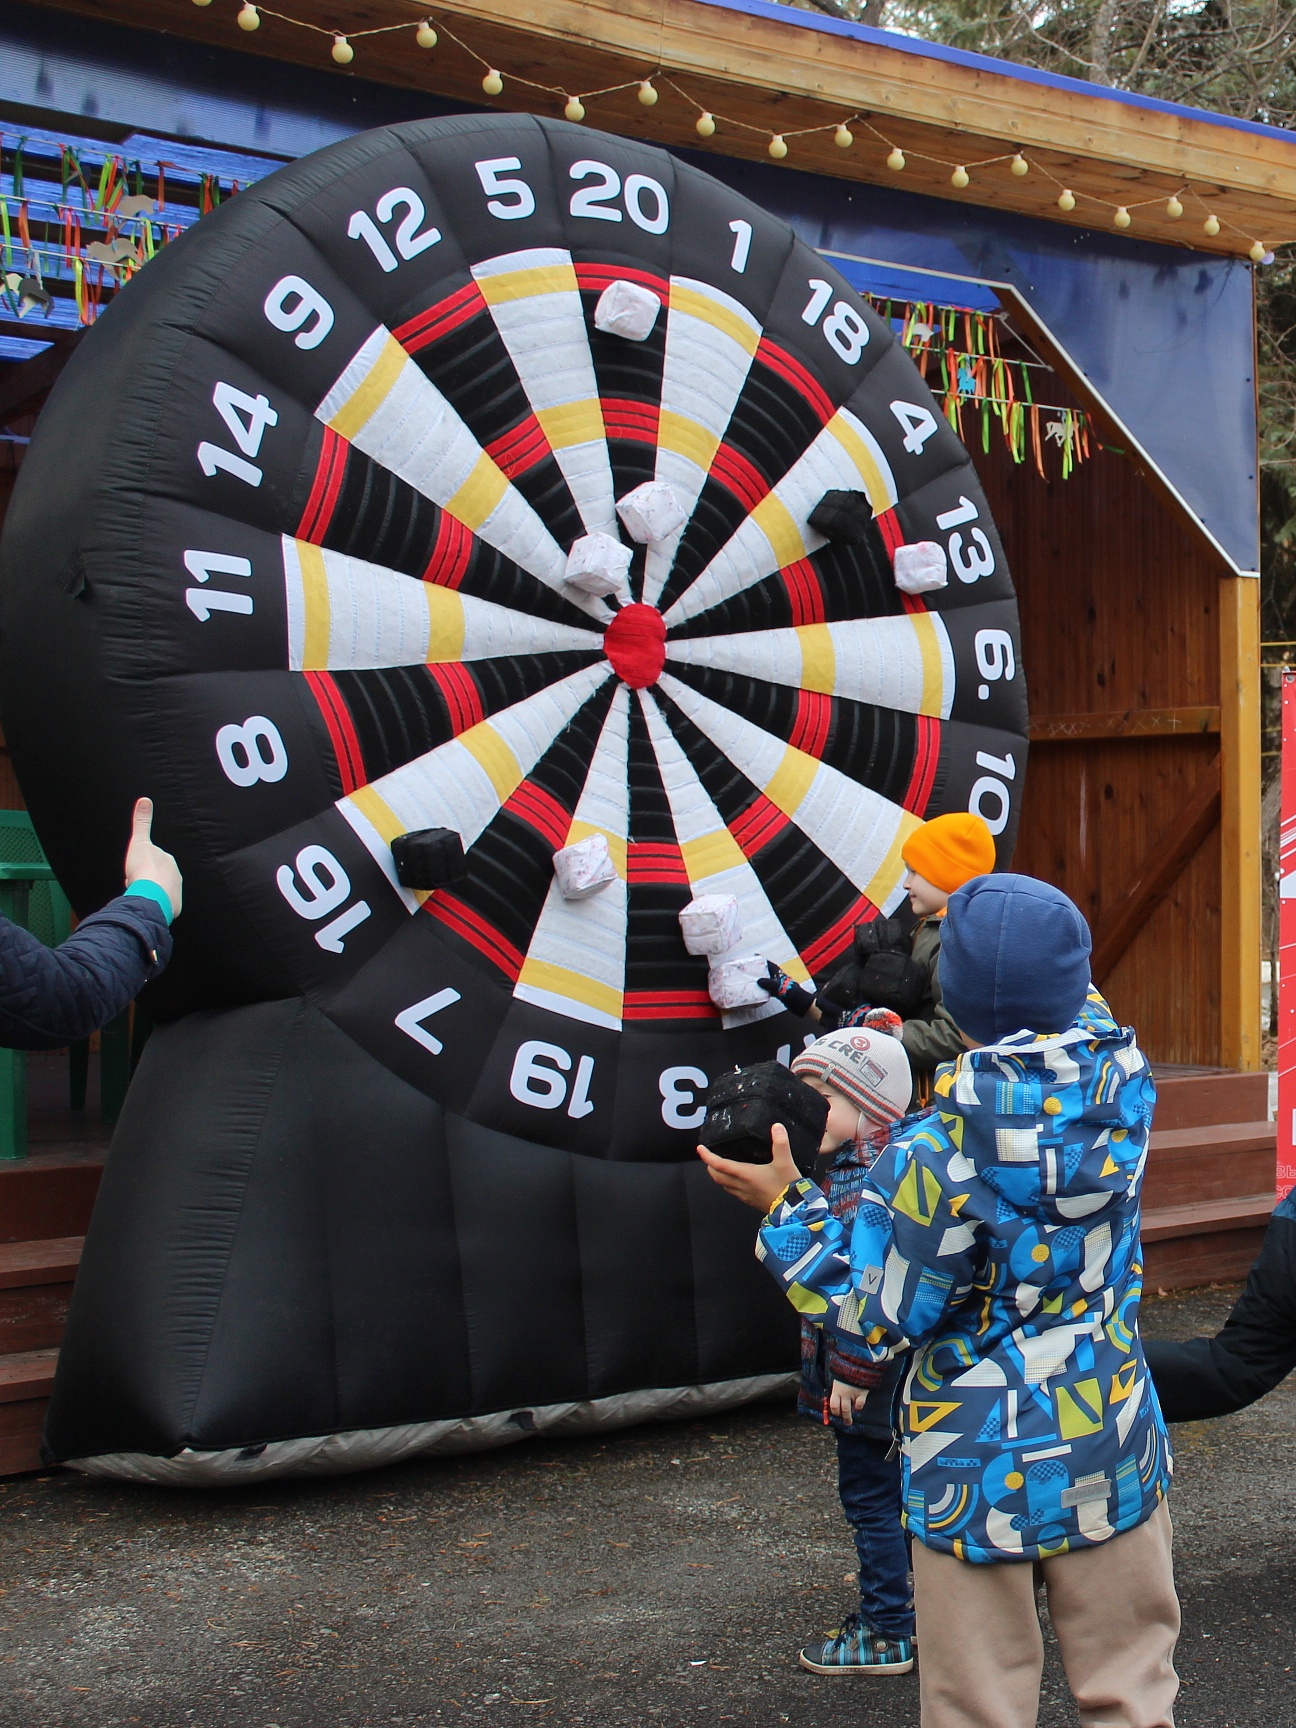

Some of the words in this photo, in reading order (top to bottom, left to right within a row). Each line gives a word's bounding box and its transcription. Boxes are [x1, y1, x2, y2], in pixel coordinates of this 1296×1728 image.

[474, 156, 536, 219] 5
[568, 159, 669, 234] 20
[347, 186, 441, 273] 12
[728, 219, 753, 274] 1
[263, 274, 335, 350] 9
[800, 278, 870, 365] 18
[196, 381, 278, 488] 14
[889, 400, 938, 456] 4
[935, 495, 995, 584] 13
[183, 549, 253, 623] 11
[215, 715, 288, 787] 8
[968, 750, 1016, 836] 10
[276, 844, 372, 954] 16
[394, 987, 461, 1056] 7
[828, 1040, 867, 1065] CRE
[509, 1040, 594, 1119] 19
[658, 1066, 709, 1130] 3
